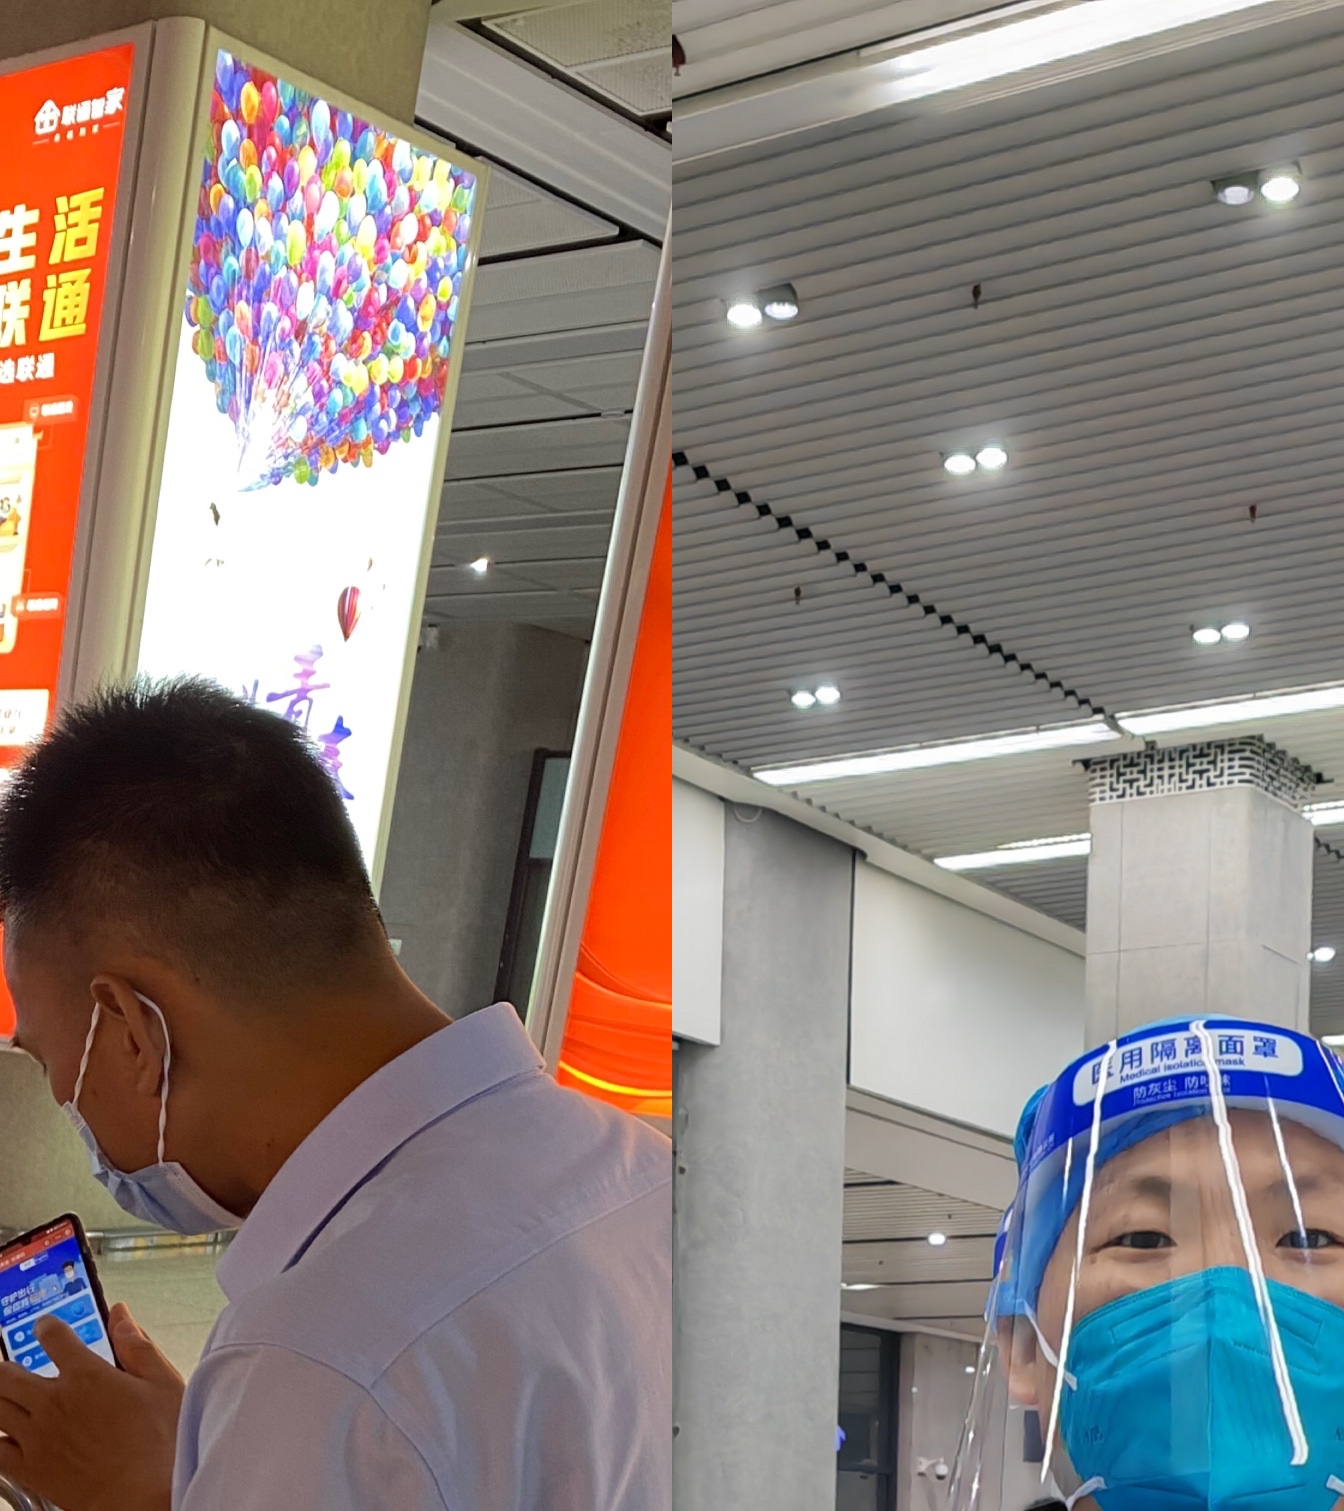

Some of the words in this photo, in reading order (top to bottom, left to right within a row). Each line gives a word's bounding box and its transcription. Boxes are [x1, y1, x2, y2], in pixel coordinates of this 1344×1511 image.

[1092, 1034, 1279, 1085] 医用隔离面罩
[1120, 1066, 1161, 1084] Medical
[1133, 1078, 1177, 1099] 防灰尘
